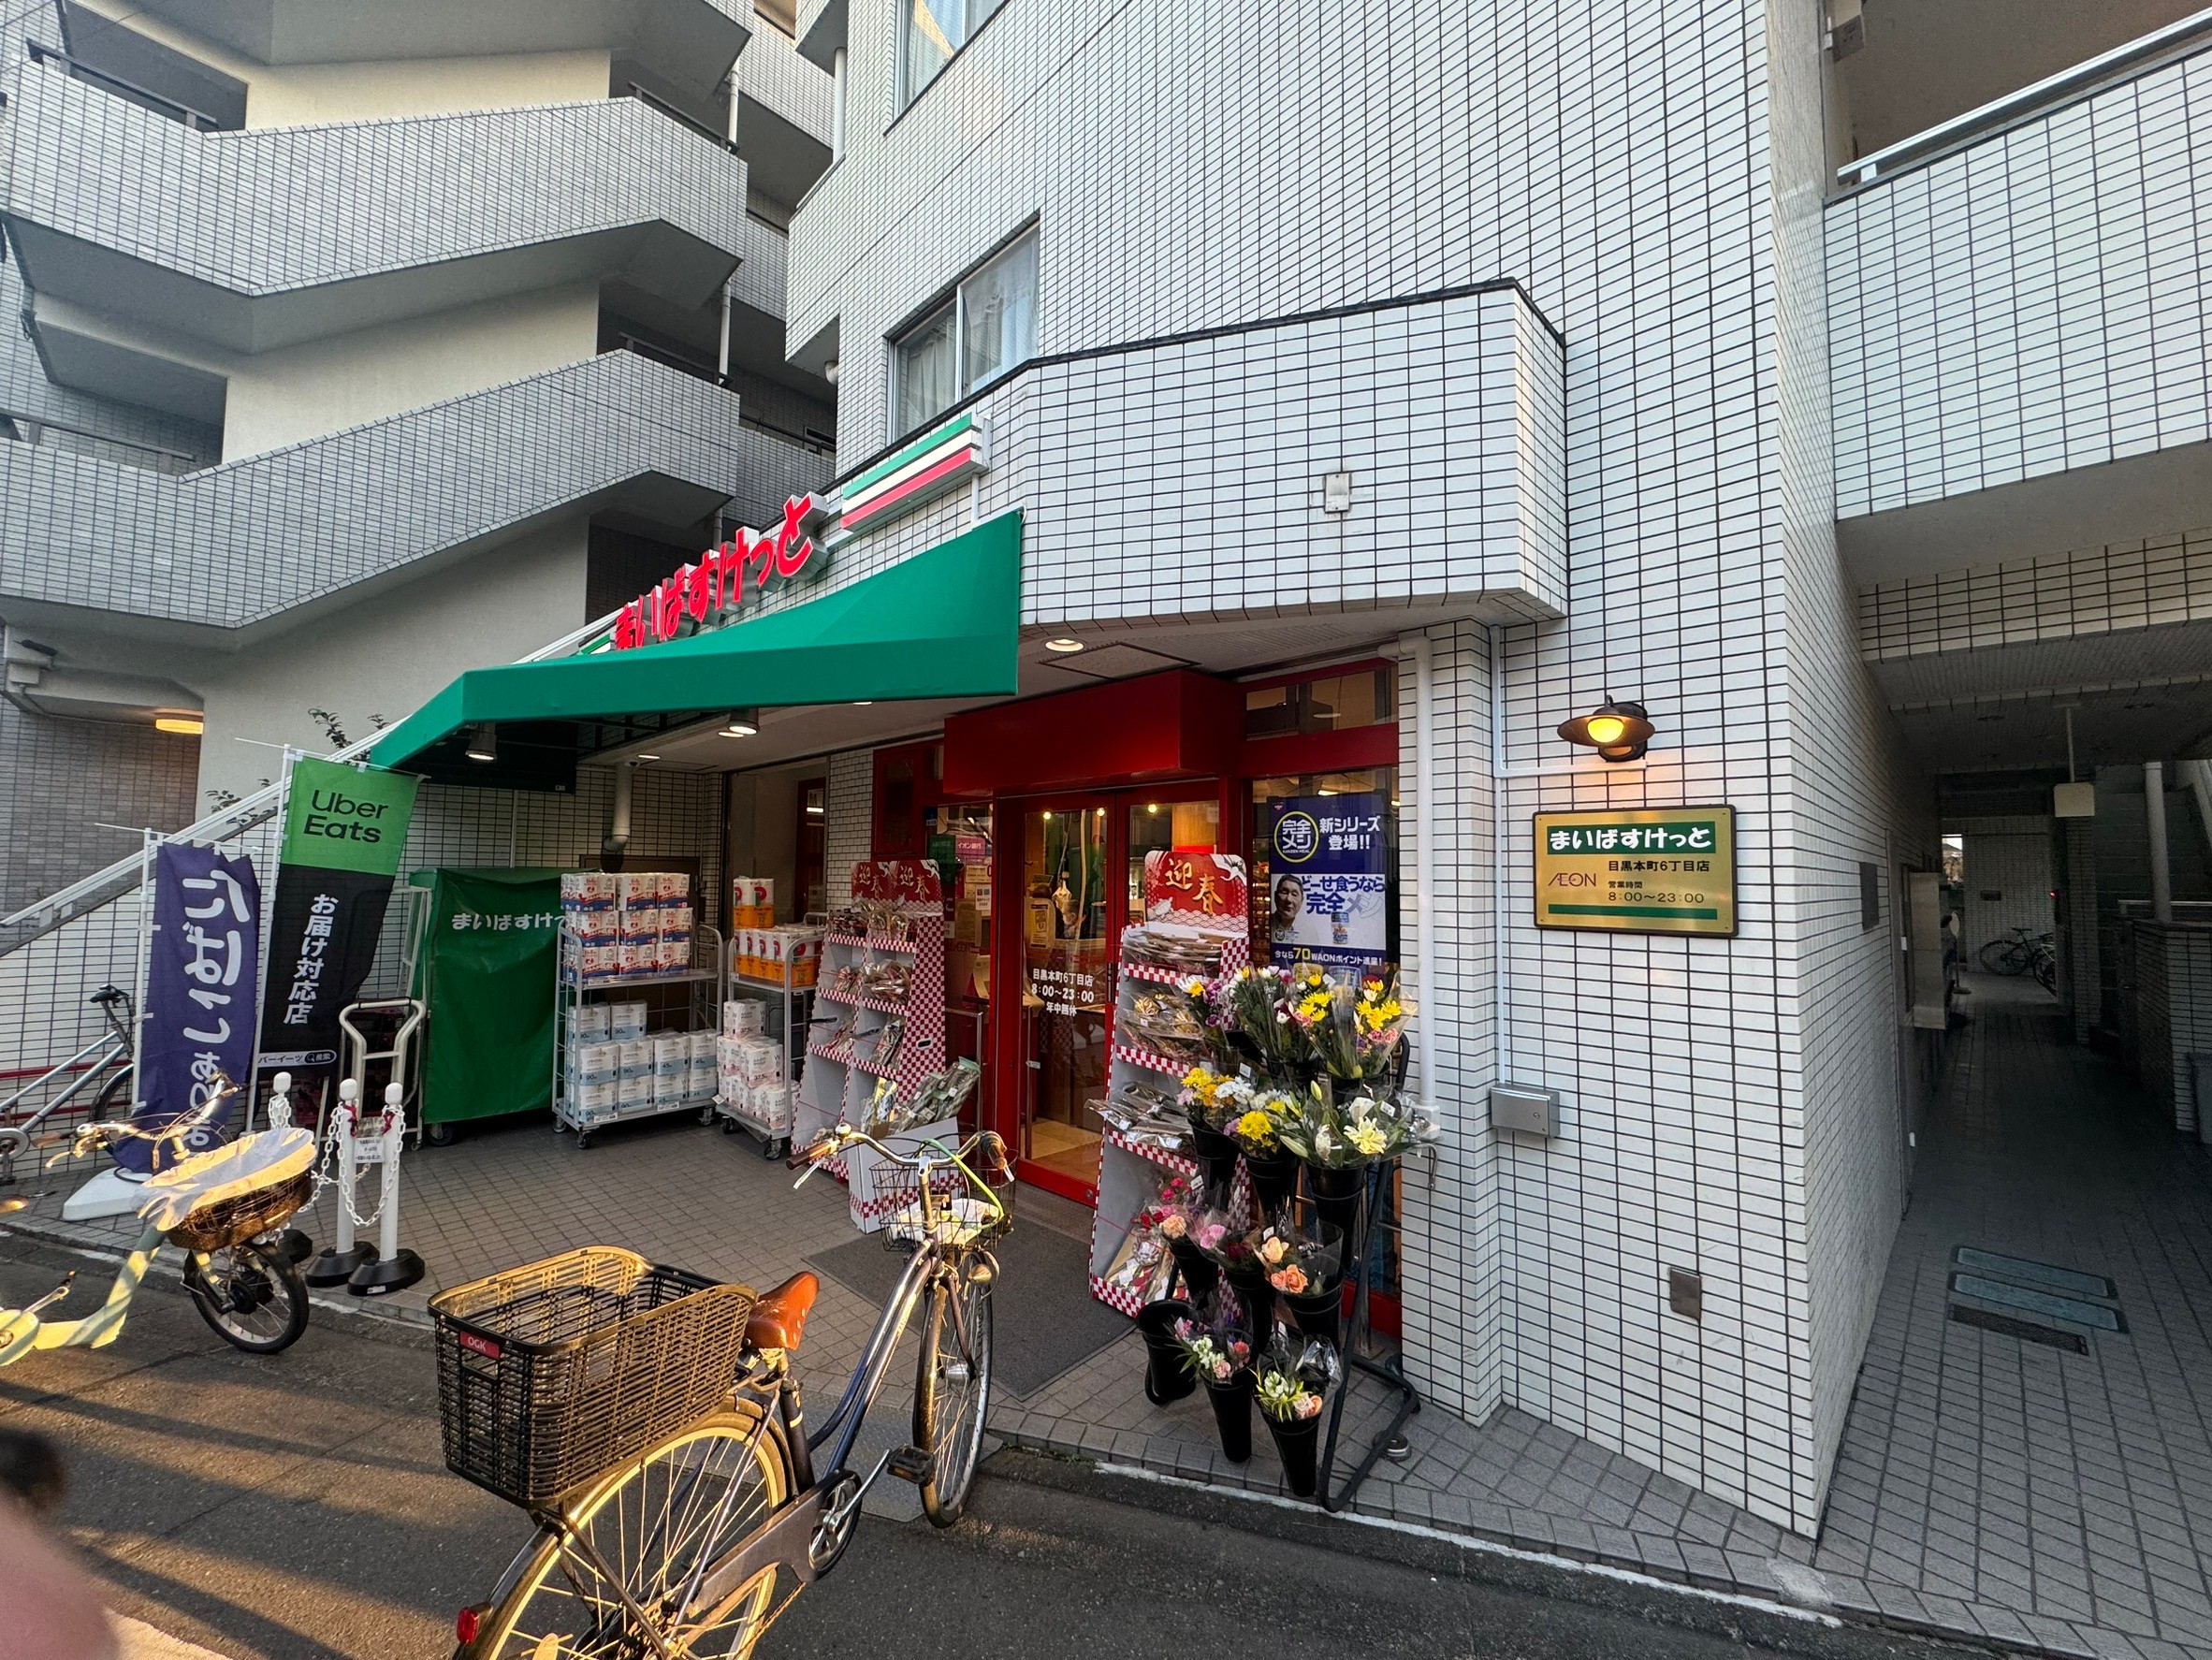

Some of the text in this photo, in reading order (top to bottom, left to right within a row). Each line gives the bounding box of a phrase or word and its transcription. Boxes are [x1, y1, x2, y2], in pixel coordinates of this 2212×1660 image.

[615, 492, 814, 650] まいばすけっと
[311, 789, 389, 821] Uber
[303, 813, 382, 844] Eats
[1282, 819, 1311, 835] 完全
[1319, 815, 1381, 834] 新シリーズ
[1282, 834, 1311, 850] メシ
[1328, 834, 1371, 851] 登場!!
[1549, 827, 1711, 851] まいばすけっと
[1608, 860, 1710, 873] 目黒本町6丁目店
[1301, 875, 1386, 894] どーせ食うなら
[1608, 881, 1643, 889] 営業時間
[283, 893, 339, 1026] お届け対応店
[1032, 968, 1094, 987] 目黒本町6丁目店
[1045, 1001, 1077, 1017] 年中無休
[468, 1336, 486, 1351] OGK
